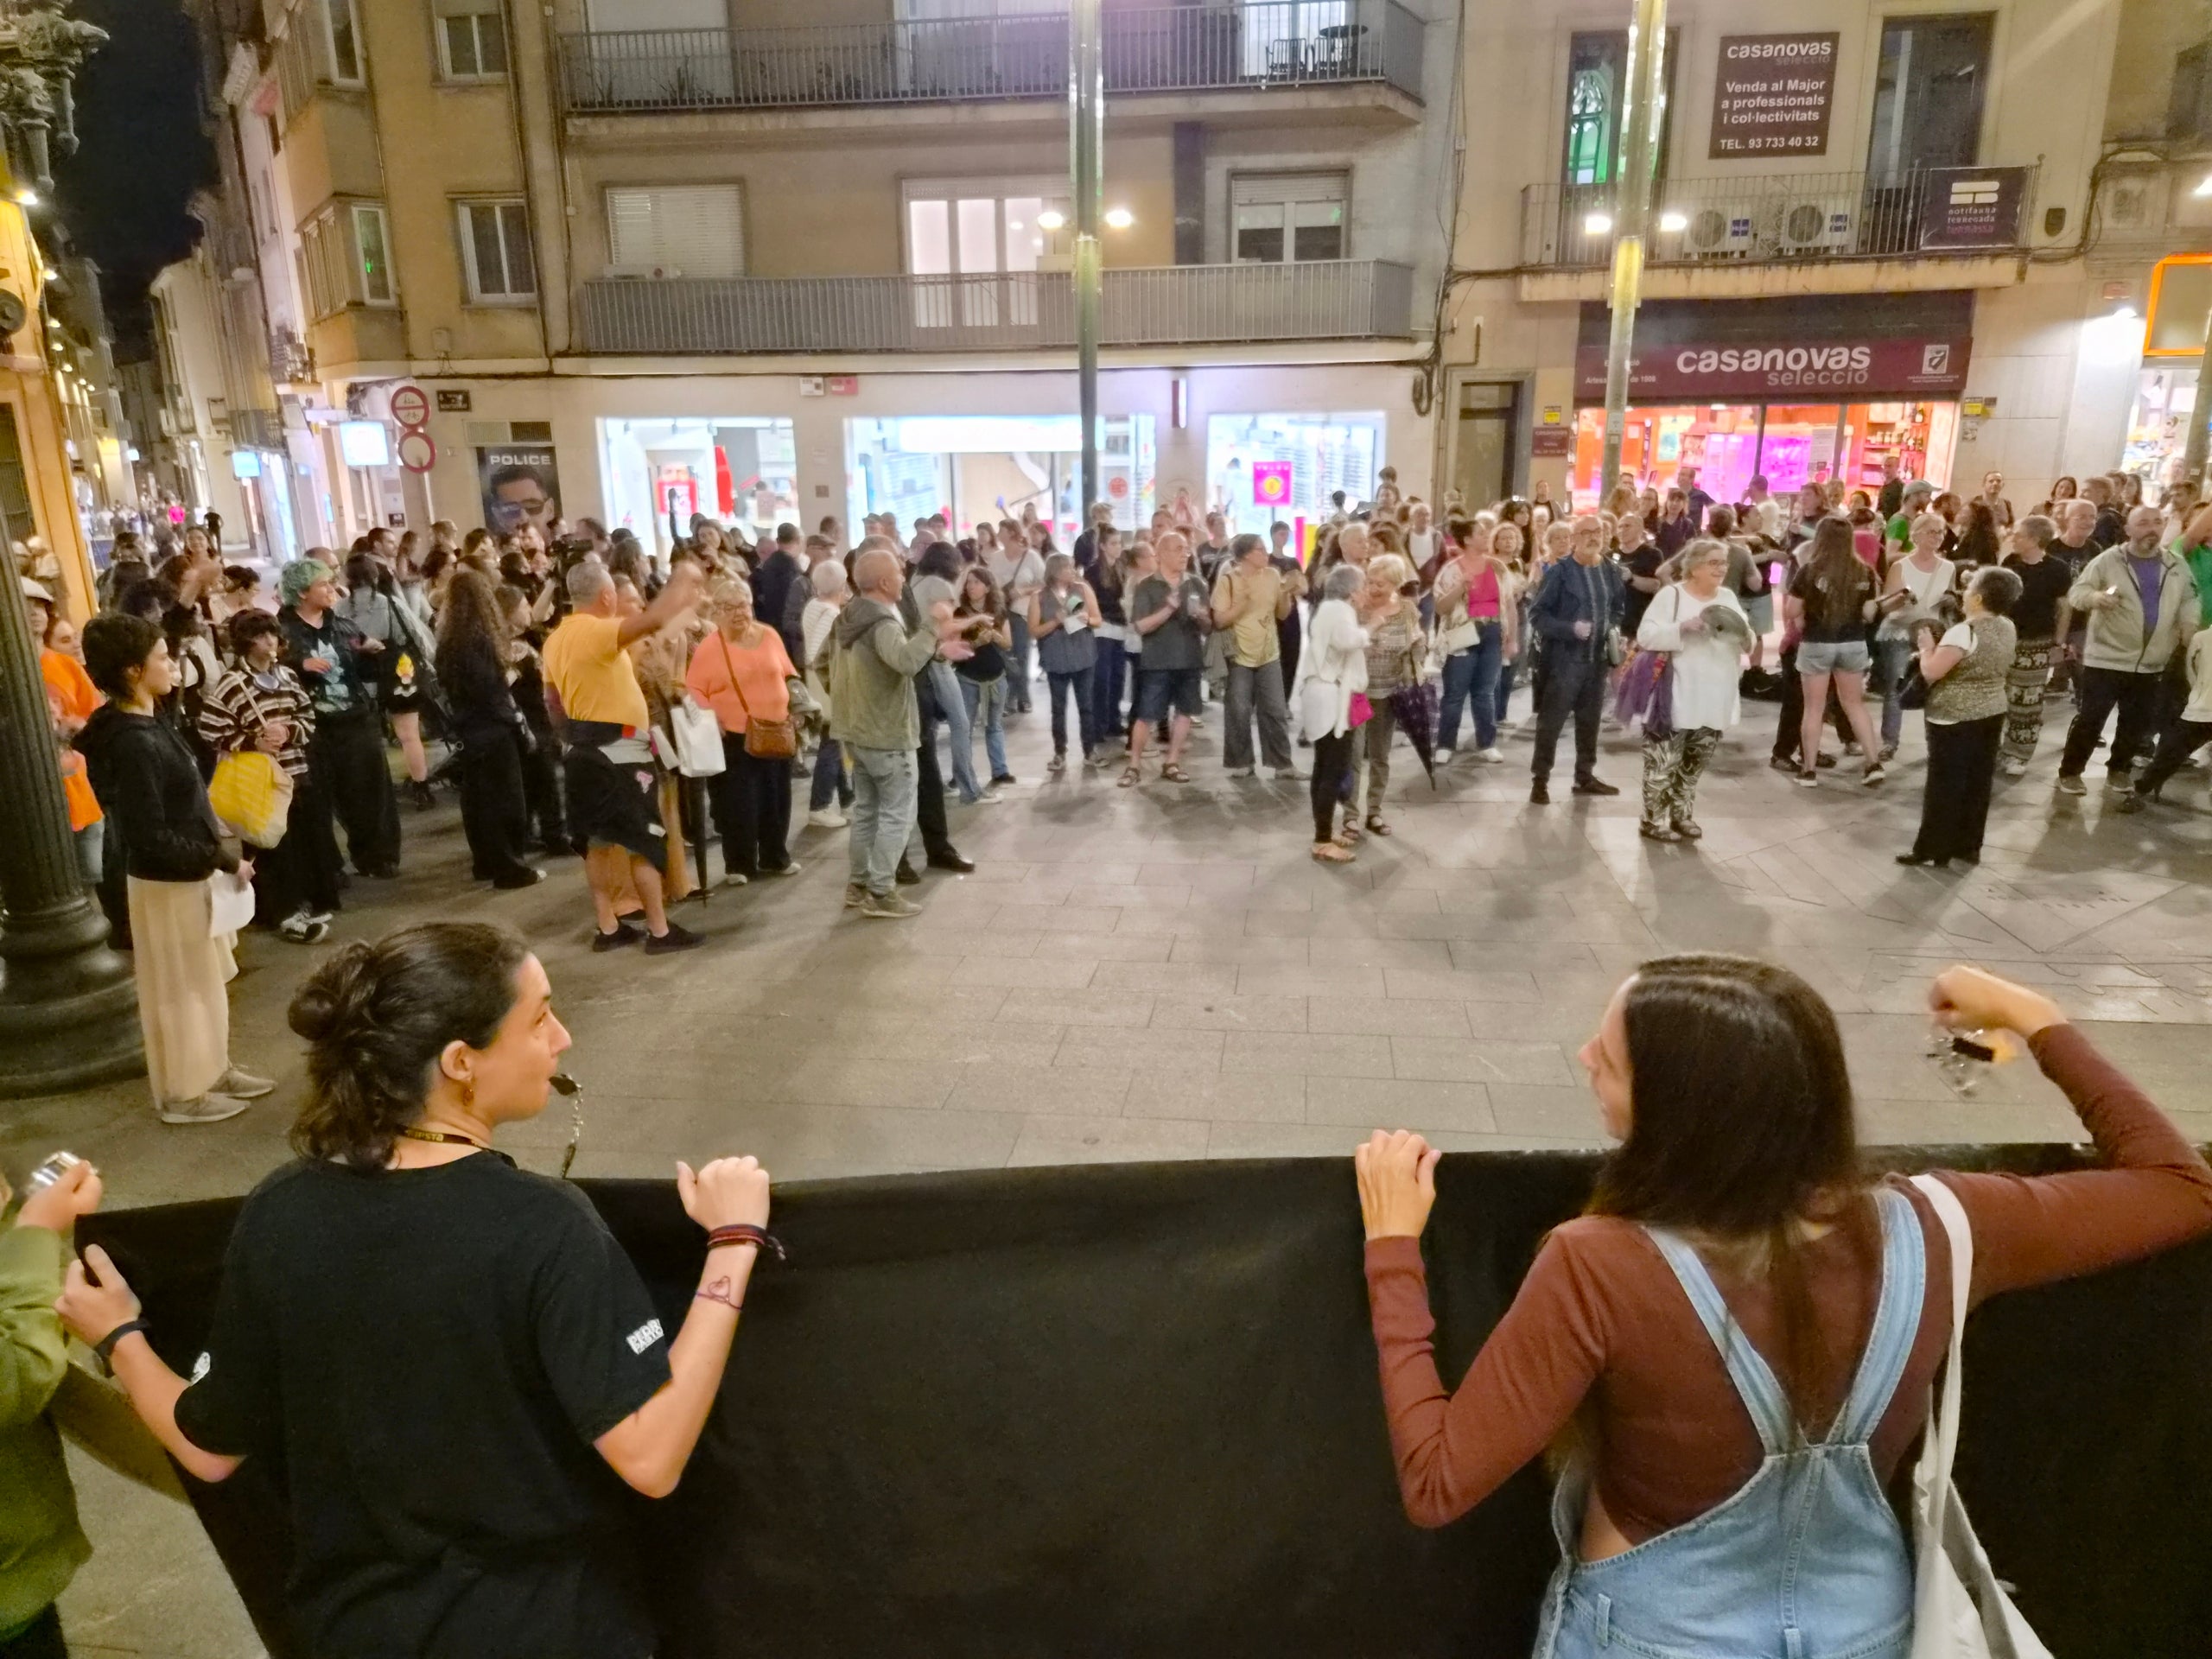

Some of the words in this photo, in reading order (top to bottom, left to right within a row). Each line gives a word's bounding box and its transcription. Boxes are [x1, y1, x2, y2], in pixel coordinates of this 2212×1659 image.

[1727, 41, 1832, 59] casanovas
[1726, 81, 1767, 92] Venda
[1770, 79, 1783, 92] al
[1787, 79, 1826, 92] Major
[1721, 99, 1729, 109] a
[1733, 94, 1825, 111] professionals
[1723, 113, 1728, 124] i
[1731, 110, 1820, 124] col·lectivitats
[1720, 139, 1745, 149] TEL.
[1748, 138, 1762, 149] 93
[1765, 137, 1785, 148] 733
[1788, 137, 1802, 147] 40
[1804, 136, 1819, 146] 32
[1676, 346, 1871, 373] casanovas
[1767, 366, 1869, 386] selecció
[489, 454, 551, 466] POLICE
